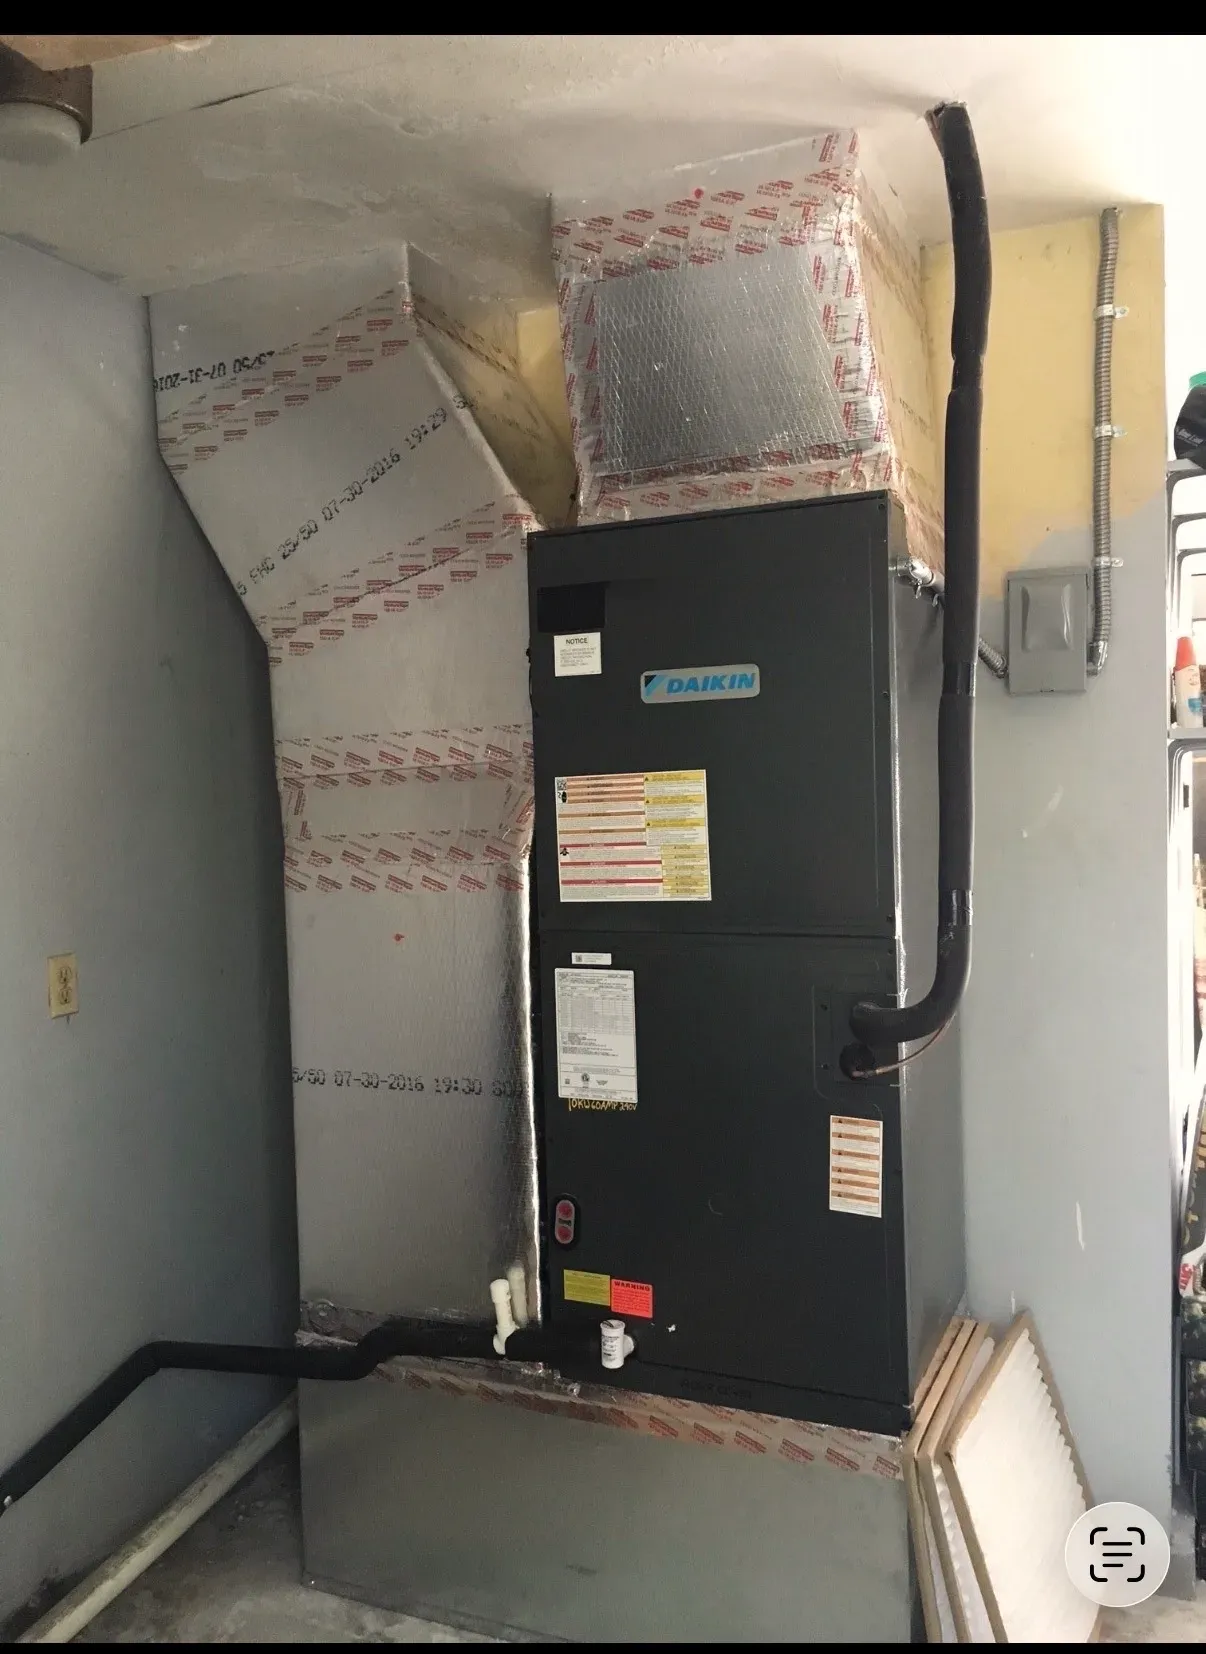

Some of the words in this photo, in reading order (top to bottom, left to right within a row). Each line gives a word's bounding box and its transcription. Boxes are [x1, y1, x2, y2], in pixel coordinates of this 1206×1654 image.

[277, 518, 319, 560] 25/50
[321, 448, 401, 522] 07-30-2016
[405, 408, 447, 450] 19:29
[667, 672, 755, 693] DAIKIN
[334, 1070, 424, 1092] 07-30-2016
[434, 1077, 482, 1096] 19:30
[614, 1281, 650, 1292] WARNING
